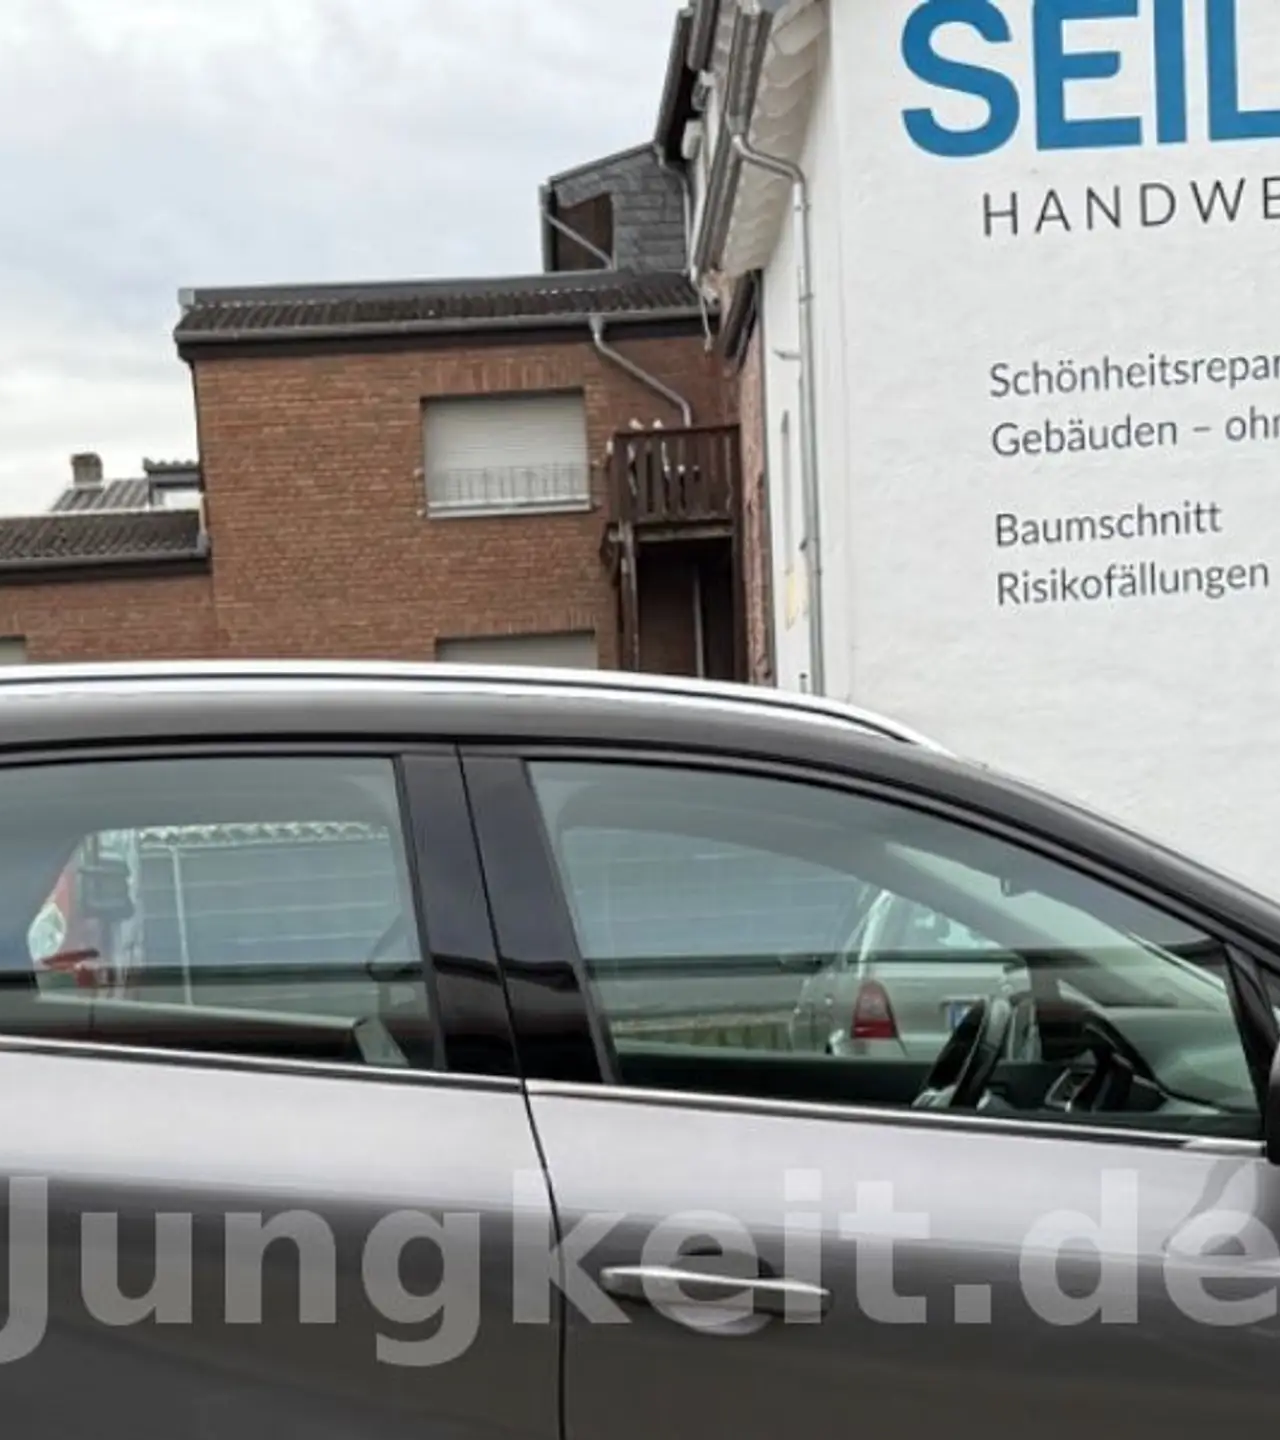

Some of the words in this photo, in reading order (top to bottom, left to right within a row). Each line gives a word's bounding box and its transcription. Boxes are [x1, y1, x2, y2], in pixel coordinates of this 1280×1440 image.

[990, 413, 1179, 458] Gebäuden
[994, 500, 1222, 549] Baumschnitt
[996, 560, 1270, 607] Risikofällungen
